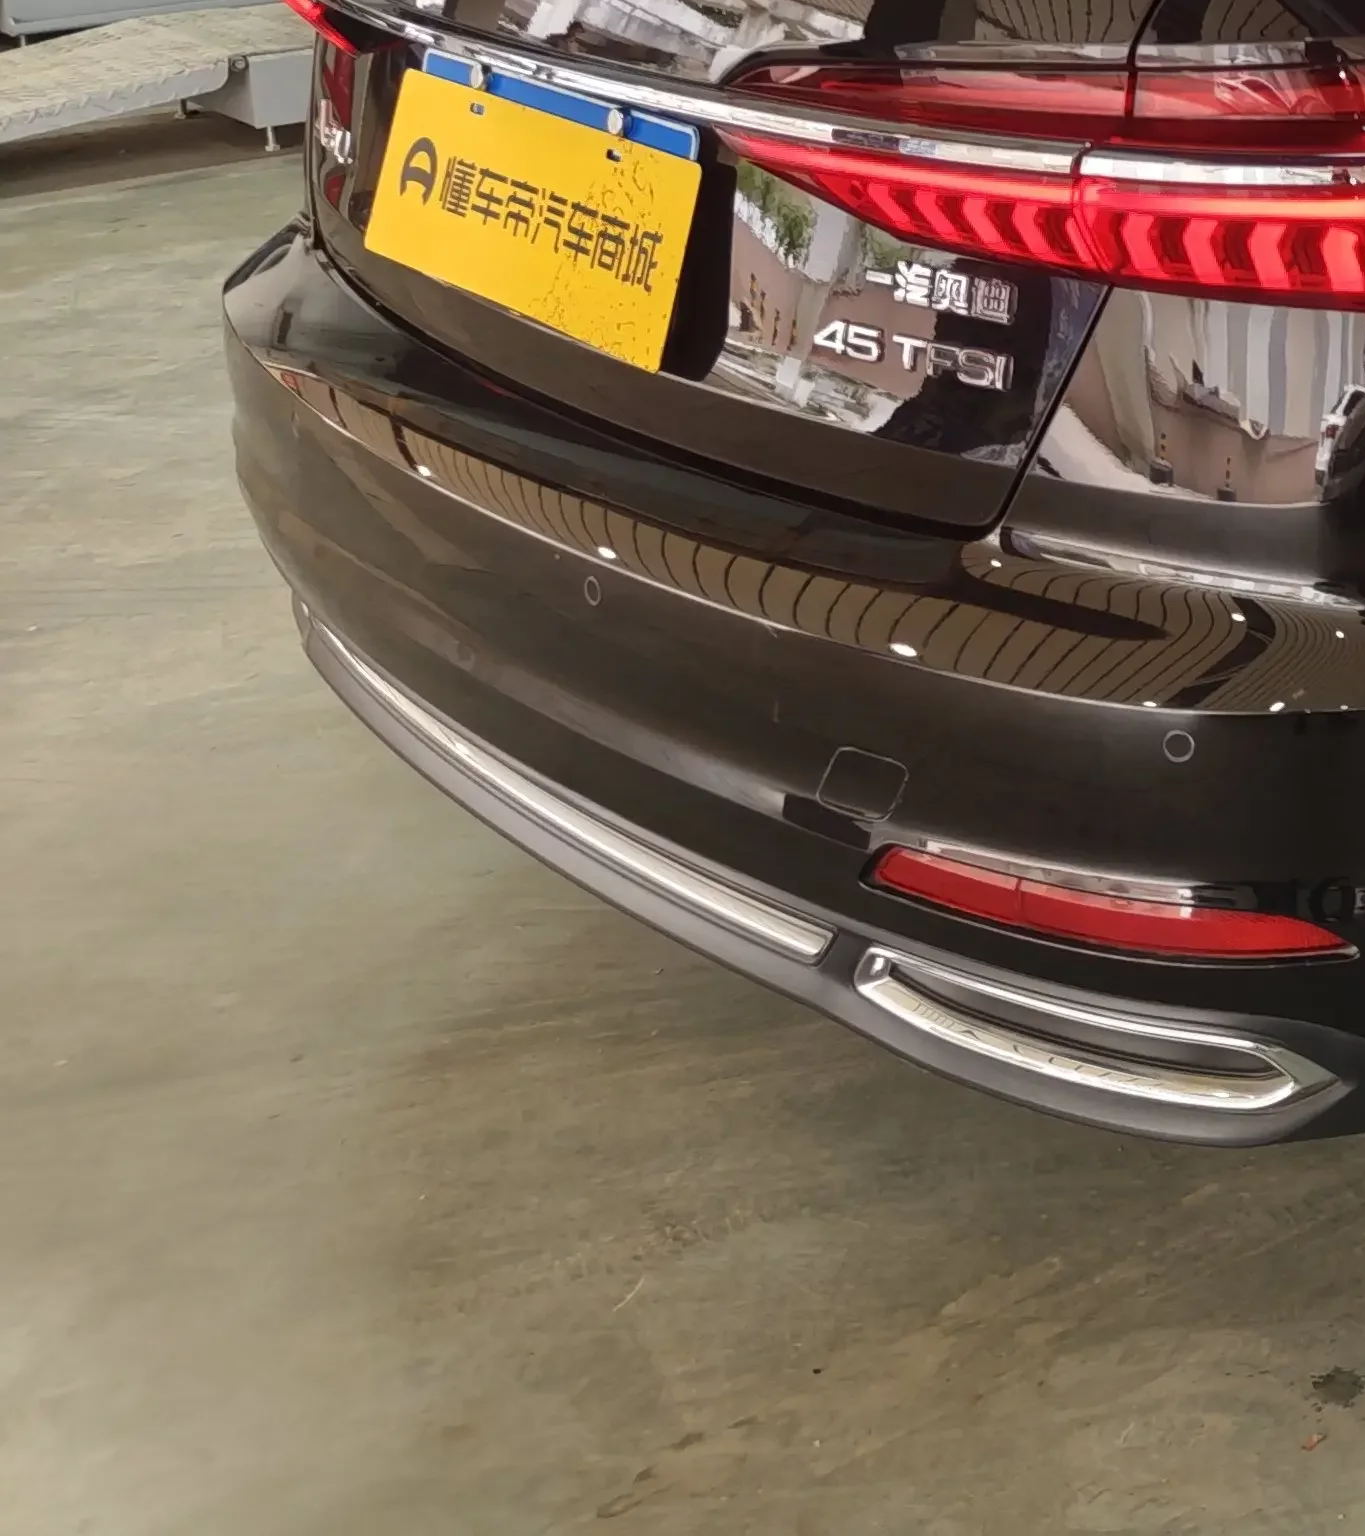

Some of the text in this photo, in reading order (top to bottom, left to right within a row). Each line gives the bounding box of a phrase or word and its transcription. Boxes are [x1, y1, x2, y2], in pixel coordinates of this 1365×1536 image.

[439, 156, 663, 292] 懂车帝汽车商城
[813, 319, 1014, 391] 45 TFSI
